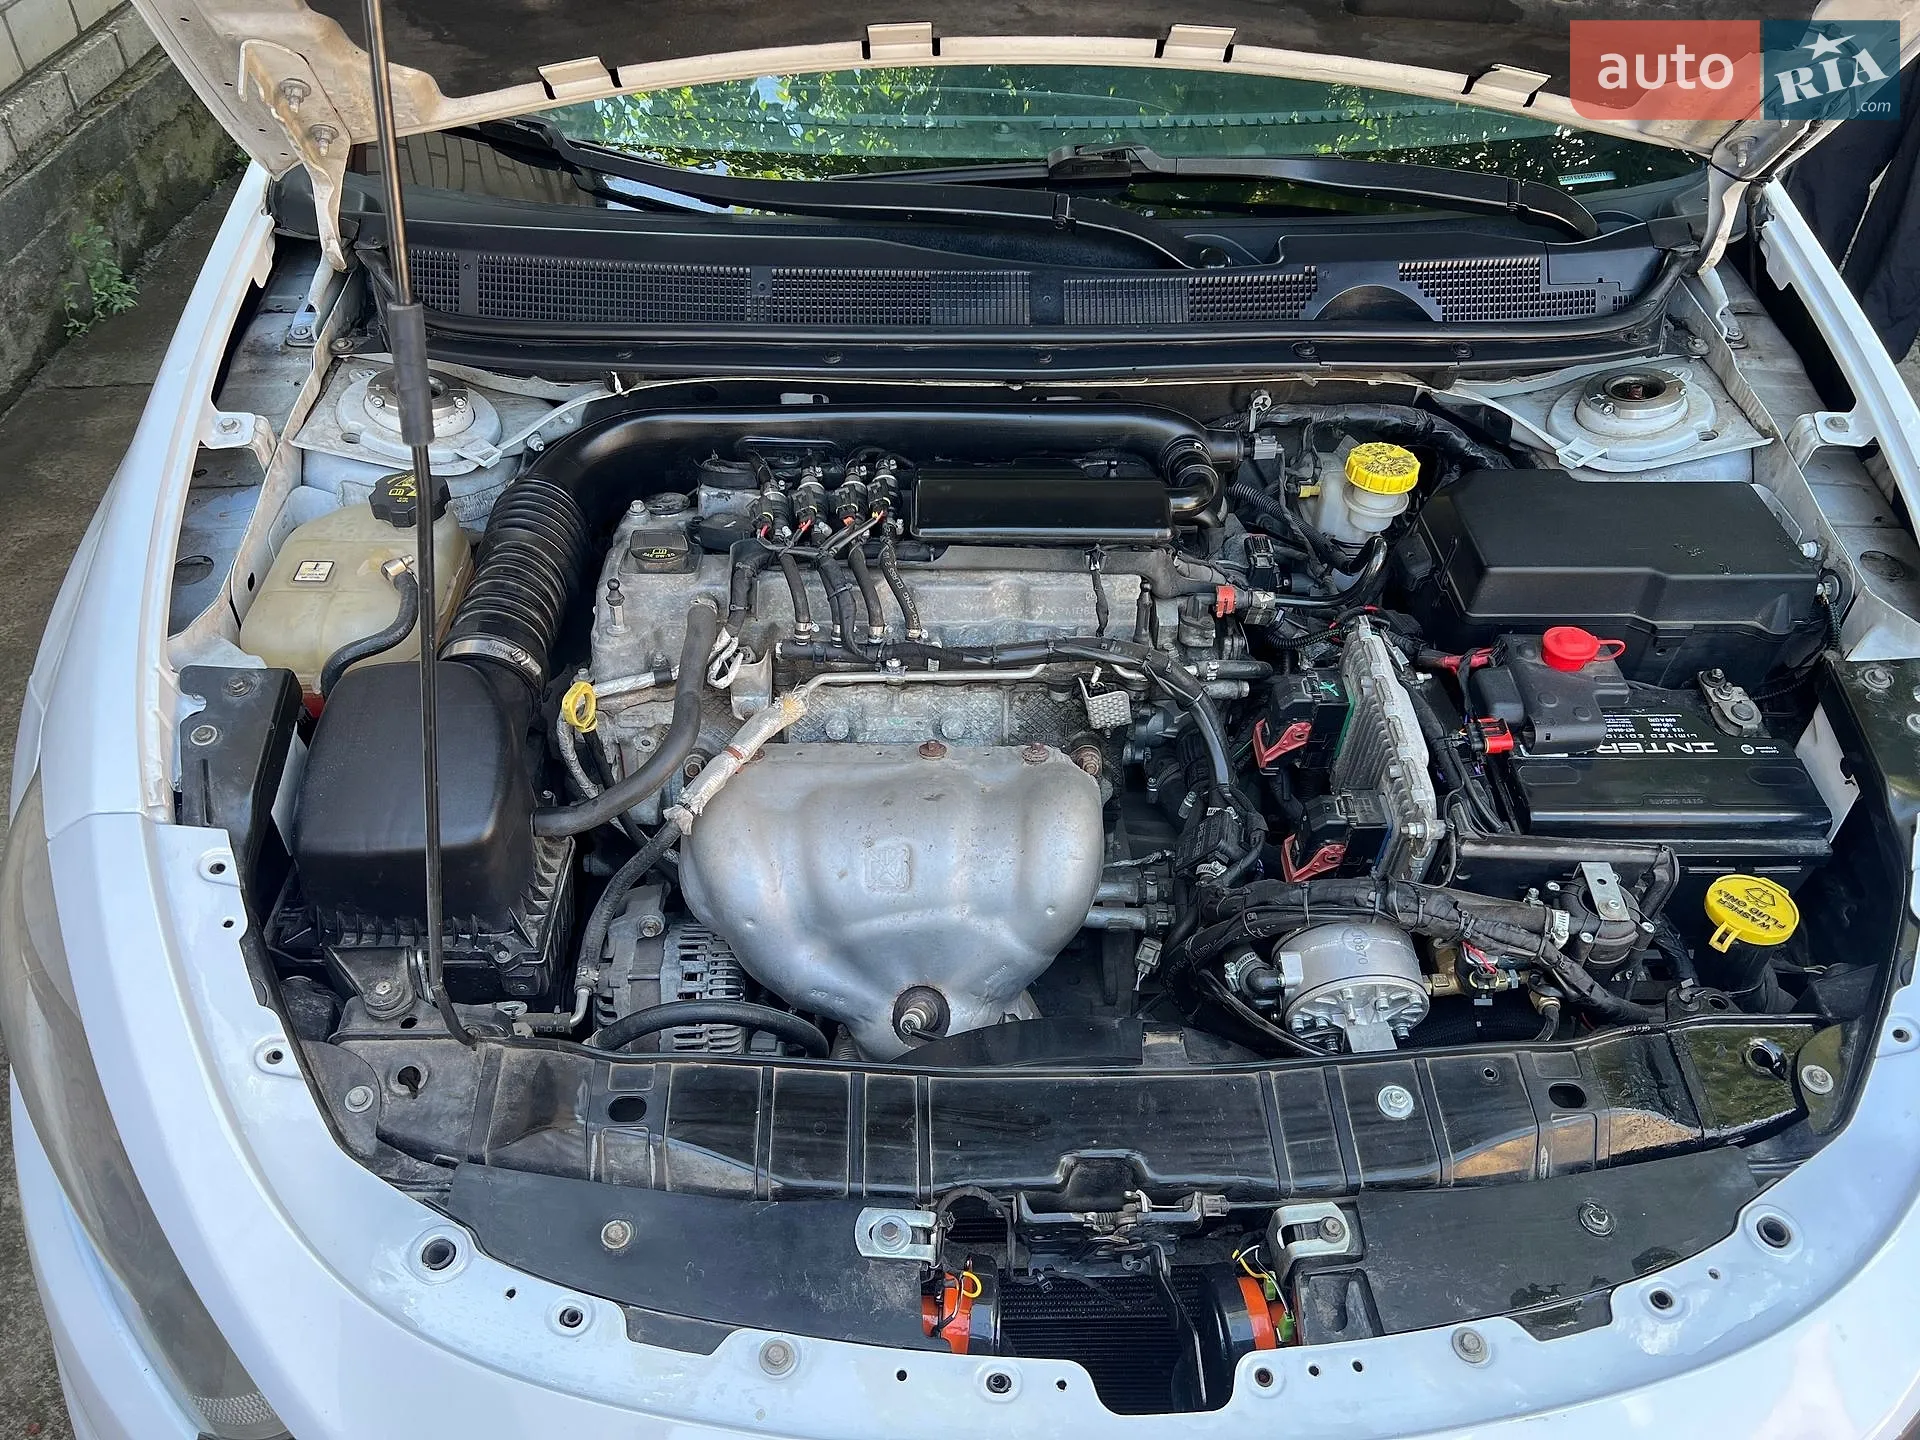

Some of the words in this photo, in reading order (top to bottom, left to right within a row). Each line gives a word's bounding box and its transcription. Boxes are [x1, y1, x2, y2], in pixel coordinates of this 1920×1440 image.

[887, 567, 904, 589] CLASS
[1595, 742, 1719, 753] INTER
[1714, 888, 1748, 908] ONLY
[1716, 897, 1771, 930] WASHER
[1749, 906, 1787, 930] FLUID
